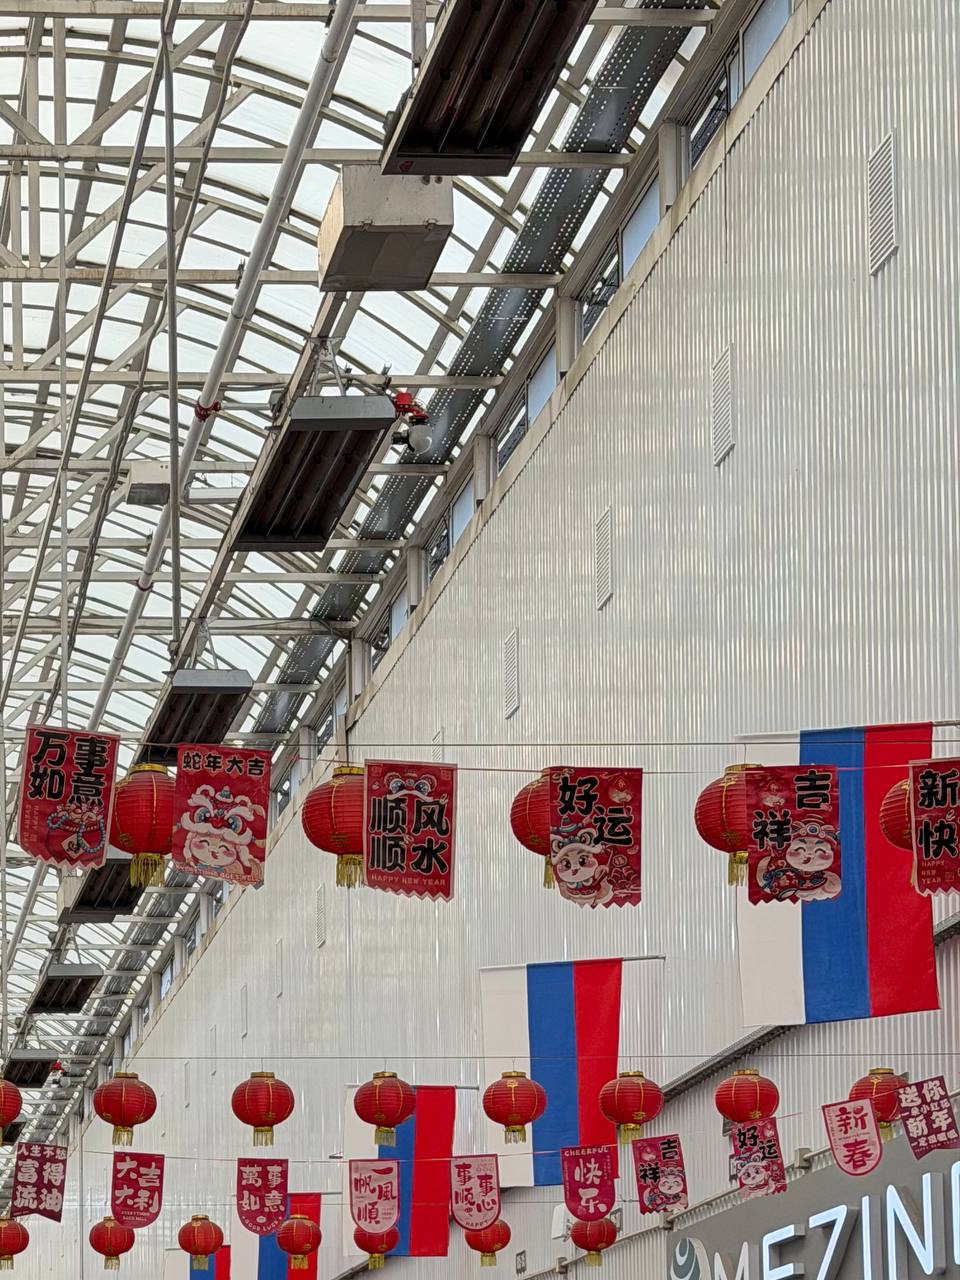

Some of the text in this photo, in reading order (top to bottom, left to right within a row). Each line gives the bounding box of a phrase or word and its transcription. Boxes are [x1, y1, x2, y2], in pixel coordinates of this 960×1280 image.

[182, 751, 266, 777] 蛇年大吉
[918, 768, 960, 810] 新
[558, 774, 635, 847] 好运
[918, 819, 960, 861] 快
[371, 874, 400, 885] HAPPY
[423, 876, 447, 887] YEAR
[835, 1105, 874, 1170] 新春
